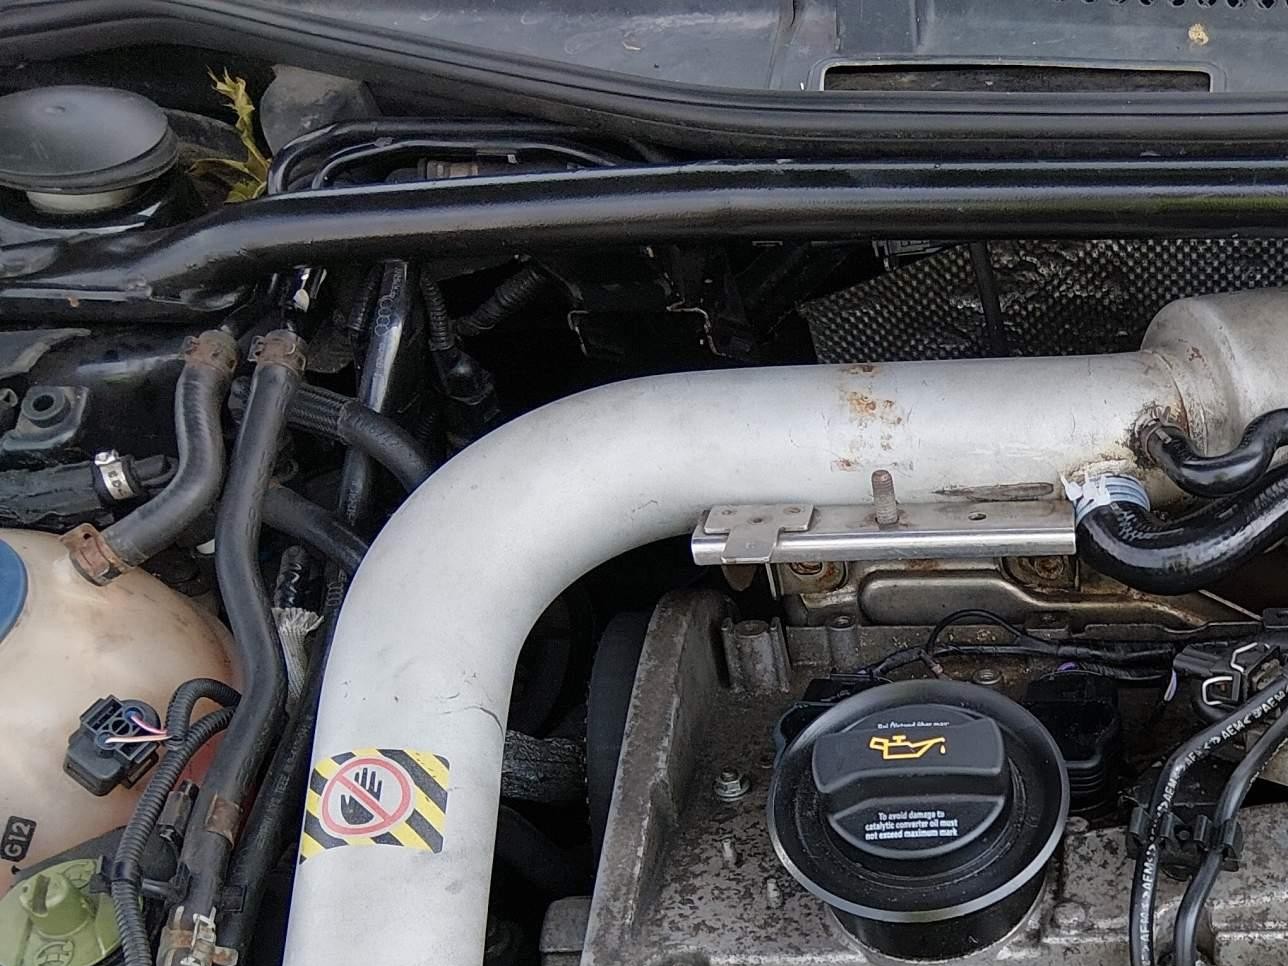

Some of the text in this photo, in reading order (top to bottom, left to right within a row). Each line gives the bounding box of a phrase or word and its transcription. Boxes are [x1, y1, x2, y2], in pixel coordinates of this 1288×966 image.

[878, 810, 945, 821] To avoid damage to
[864, 818, 958, 832] catalytic converter oil must
[4, 821, 31, 857] G12
[865, 828, 958, 840] not exceed maximum mark
